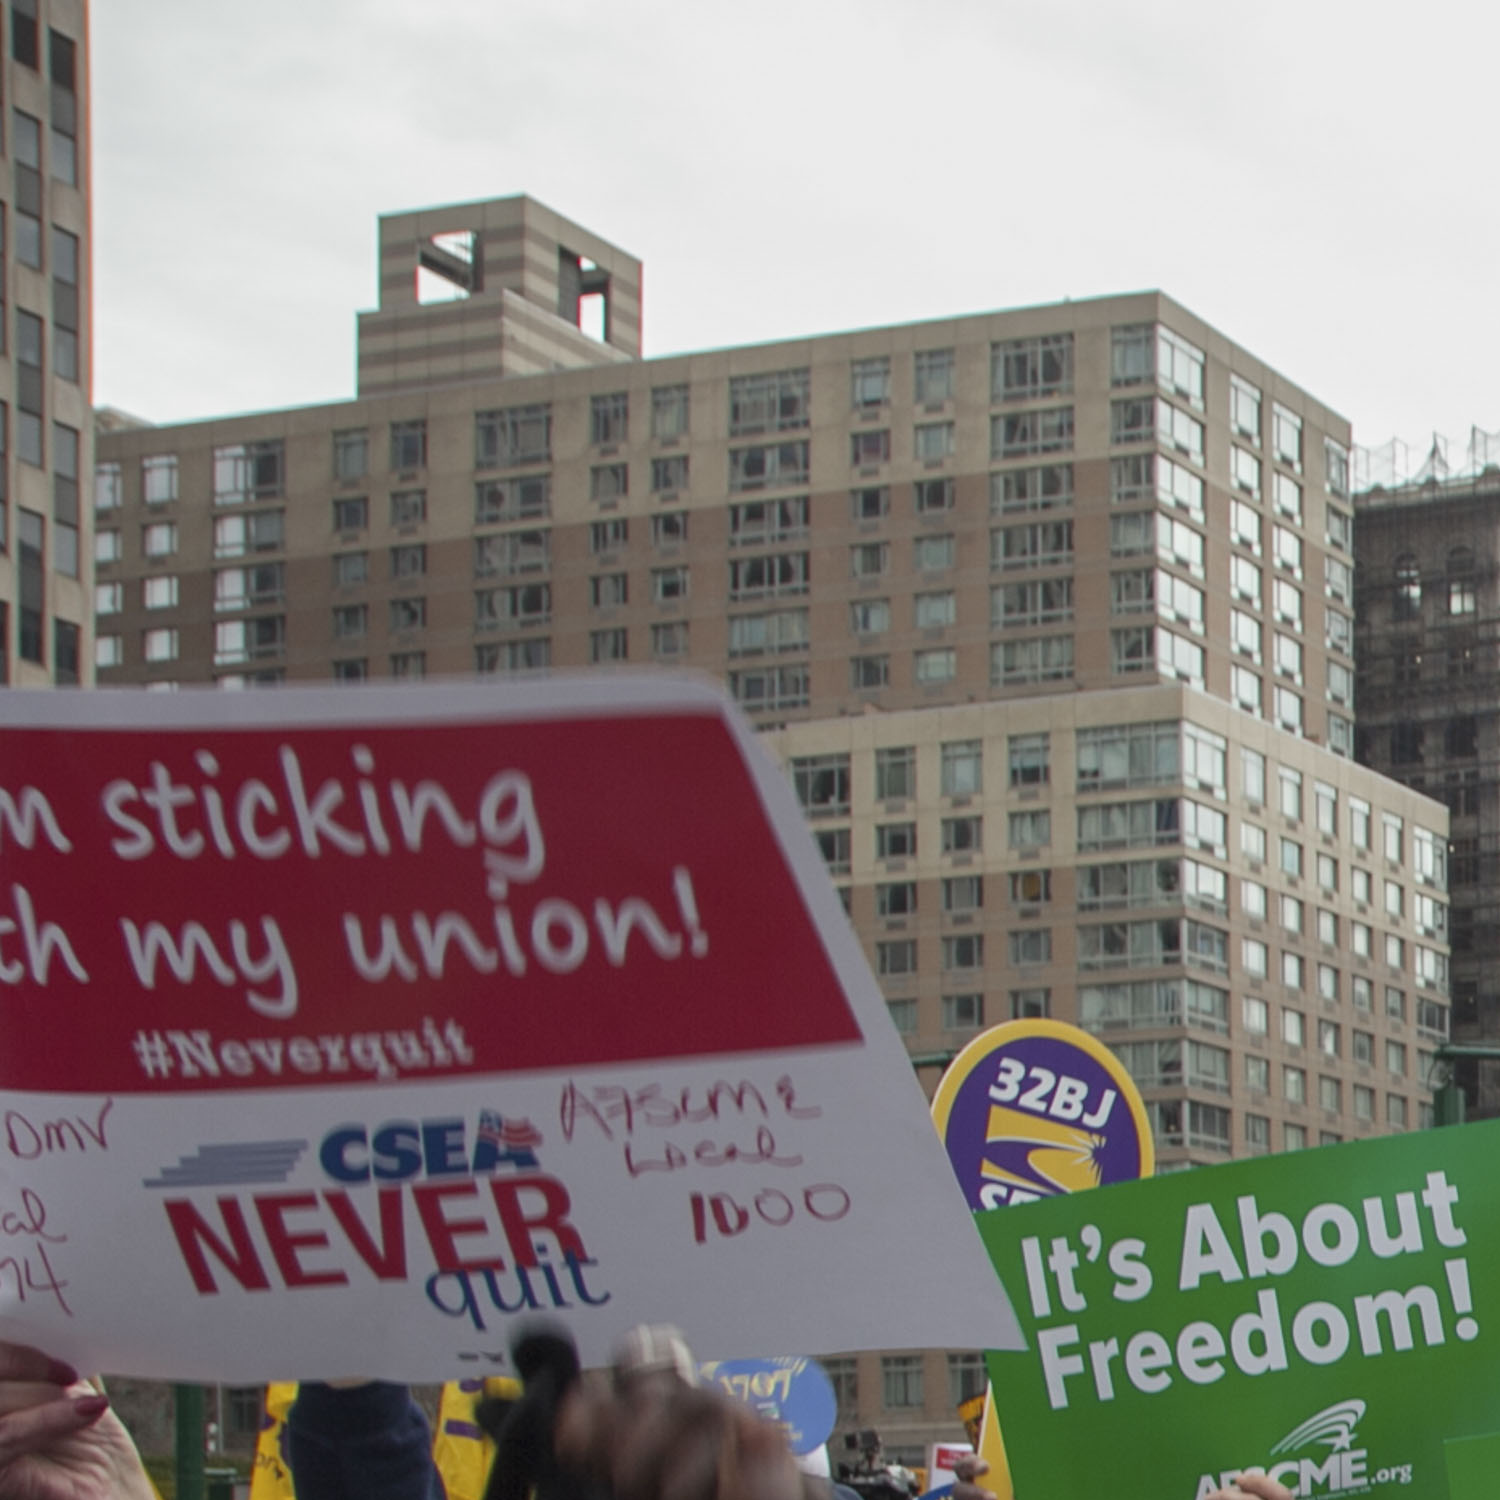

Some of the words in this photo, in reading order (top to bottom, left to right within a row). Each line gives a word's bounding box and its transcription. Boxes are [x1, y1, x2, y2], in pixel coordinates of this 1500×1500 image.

[104, 746, 544, 882] sticking
[120, 916, 298, 1017] my
[343, 863, 709, 978] union!
[133, 1016, 474, 1080] #Neverquit
[988, 1056, 1117, 1129] 32BJ
[320, 1108, 541, 1184] CSEA
[163, 1173, 590, 1296] NEVER
[425, 1242, 612, 1332] quit
[1021, 1224, 1154, 1318] It's
[1179, 1170, 1467, 1291] About
[1037, 1257, 1479, 1410] Freedom!
